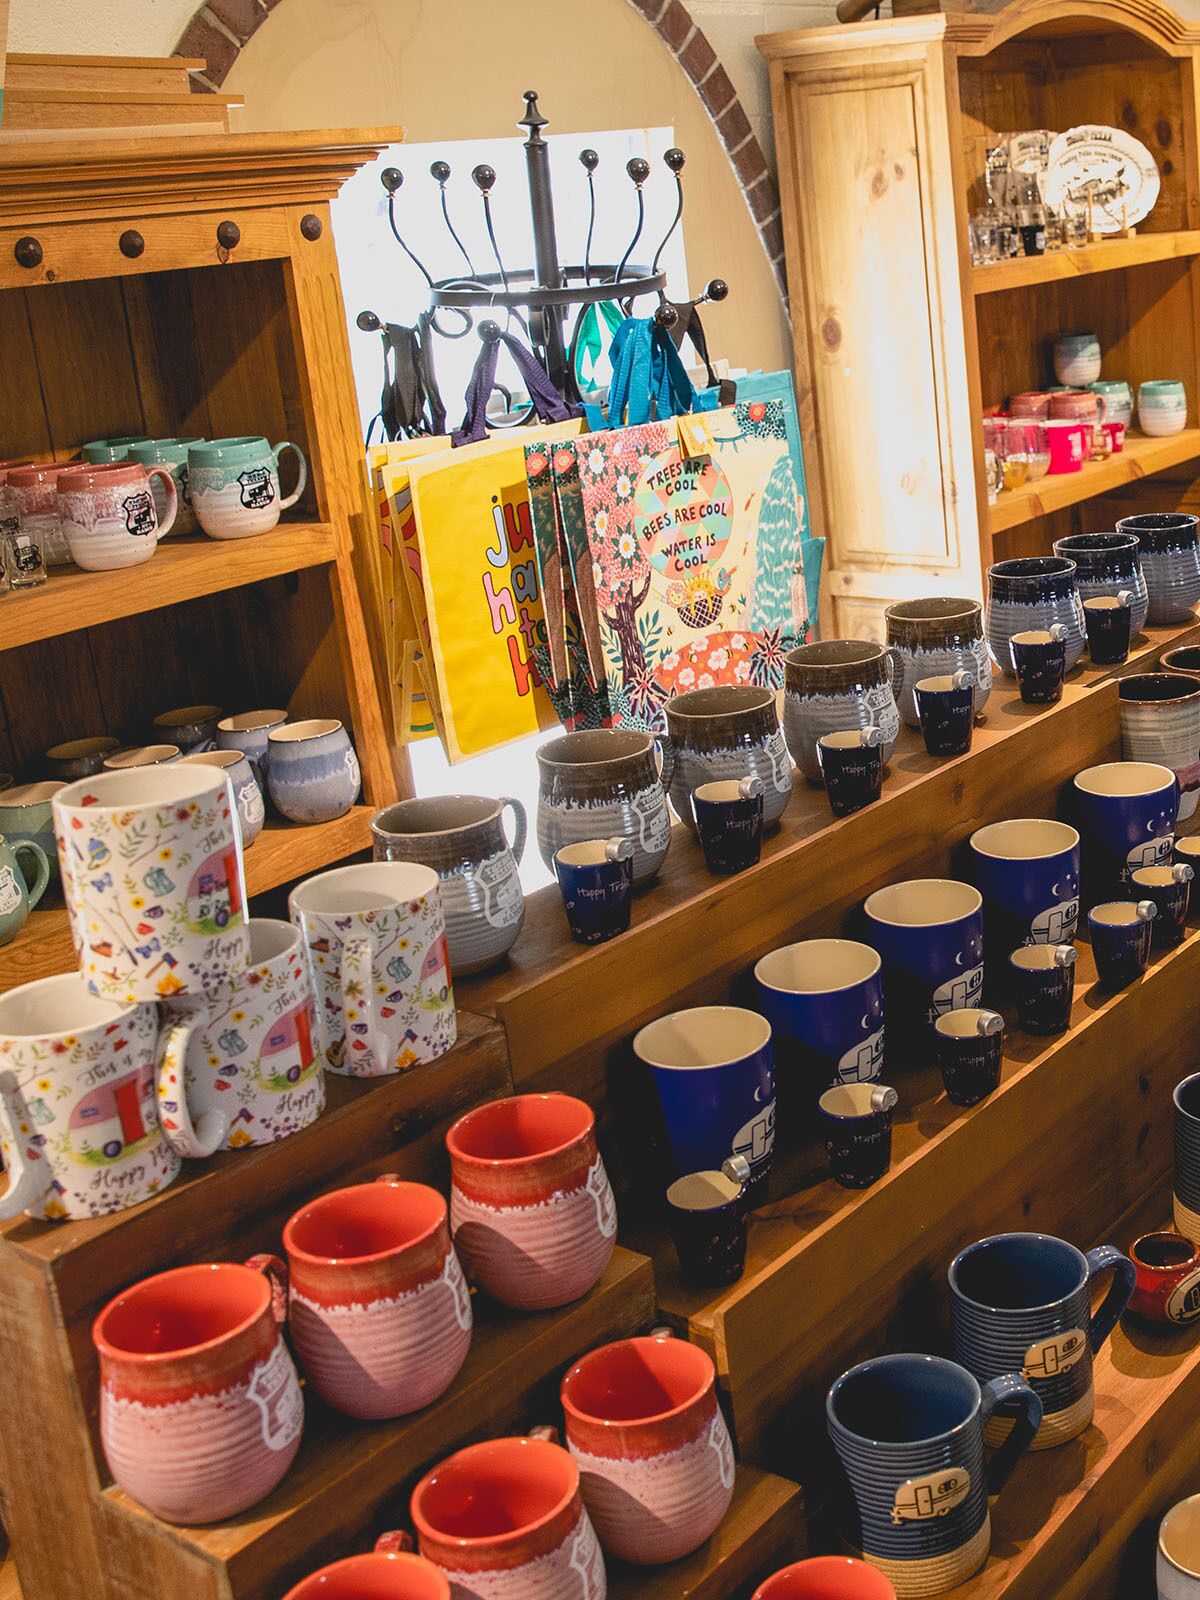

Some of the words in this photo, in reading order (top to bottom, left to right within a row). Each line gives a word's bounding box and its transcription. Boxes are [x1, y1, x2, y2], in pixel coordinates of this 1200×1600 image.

[647, 462, 682, 490] TREES
[684, 460, 709, 476] ARE
[665, 479, 698, 496] COOL
[642, 512, 672, 541] BEES
[674, 506, 696, 524] ARE
[699, 502, 727, 519] COOL
[661, 535, 702, 558] WATER
[706, 533, 717, 546] IS
[674, 554, 708, 572] COOL
[841, 765, 866, 776] Happy
[577, 887, 606, 902] Happy
[203, 936, 243, 960] Happy
[276, 1089, 315, 1114] Happy
[90, 1165, 146, 1190] Happy
